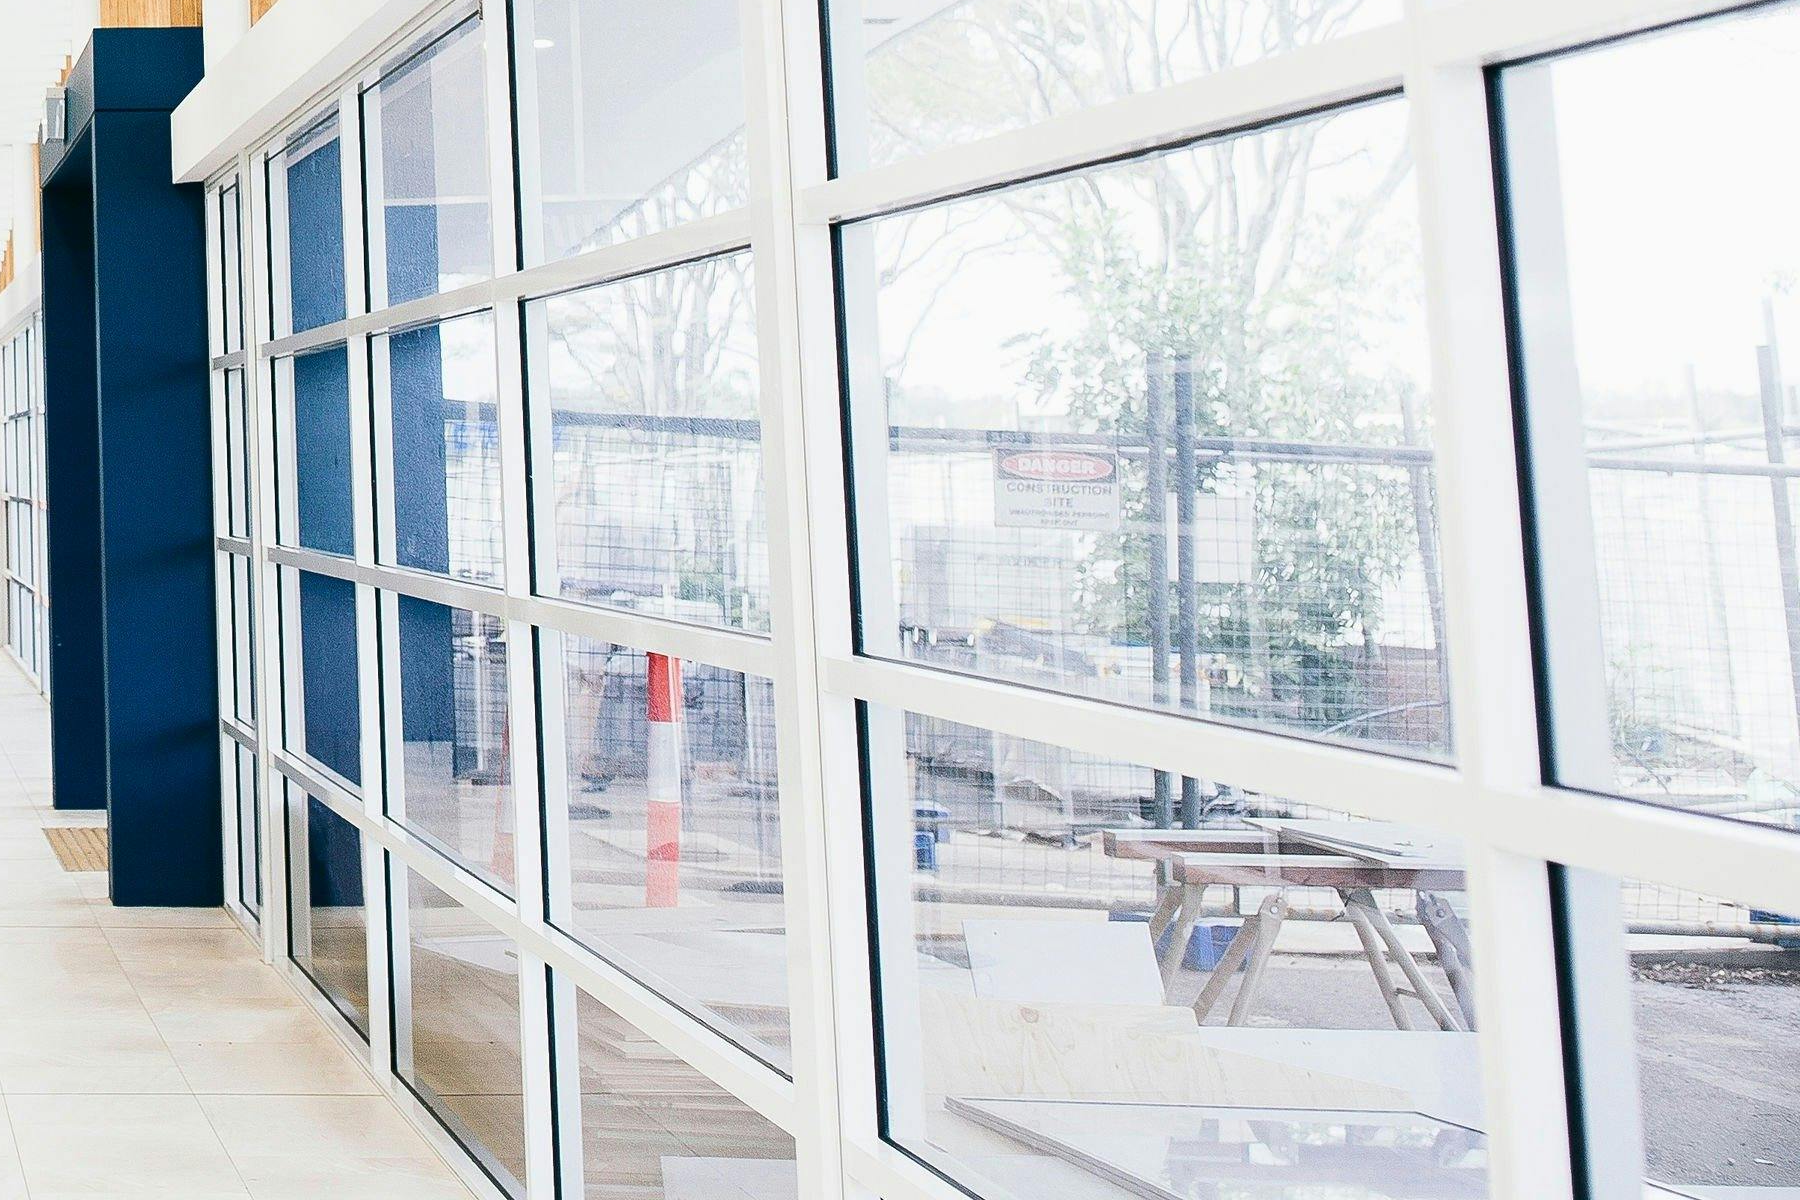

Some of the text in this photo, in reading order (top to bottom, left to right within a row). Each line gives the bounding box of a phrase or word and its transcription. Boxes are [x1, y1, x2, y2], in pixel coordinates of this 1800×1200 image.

[1017, 457, 1097, 475] DANGER
[1006, 481, 1112, 495] CONSTRUCTION
[1044, 497, 1074, 508] SITE
